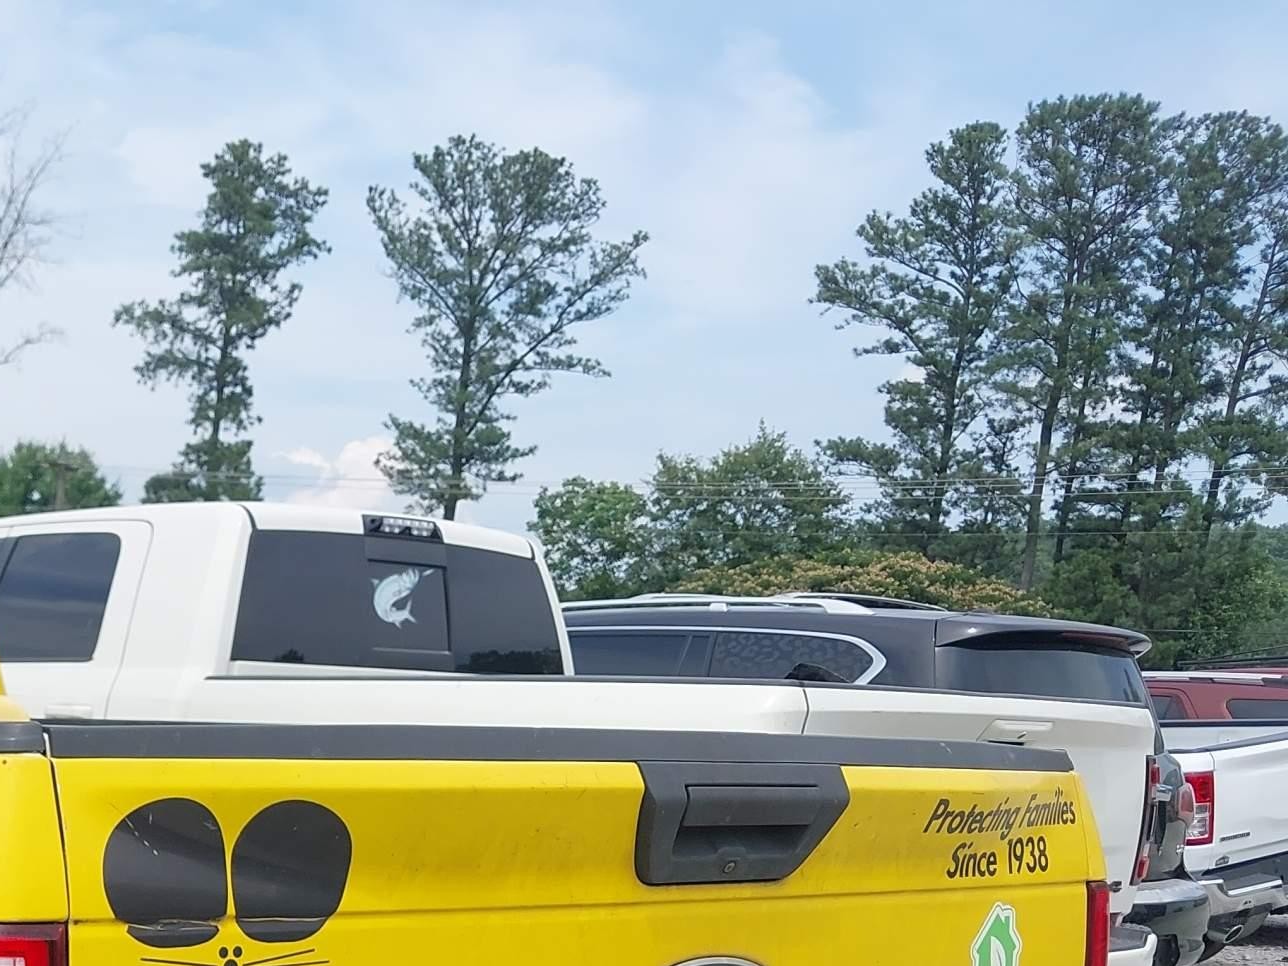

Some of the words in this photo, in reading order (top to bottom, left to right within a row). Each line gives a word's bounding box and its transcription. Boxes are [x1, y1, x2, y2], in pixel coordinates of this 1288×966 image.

[923, 797, 1020, 840] Protecting
[1019, 786, 1076, 828] Families
[946, 842, 997, 878] Since
[1008, 836, 1049, 874] 1938
